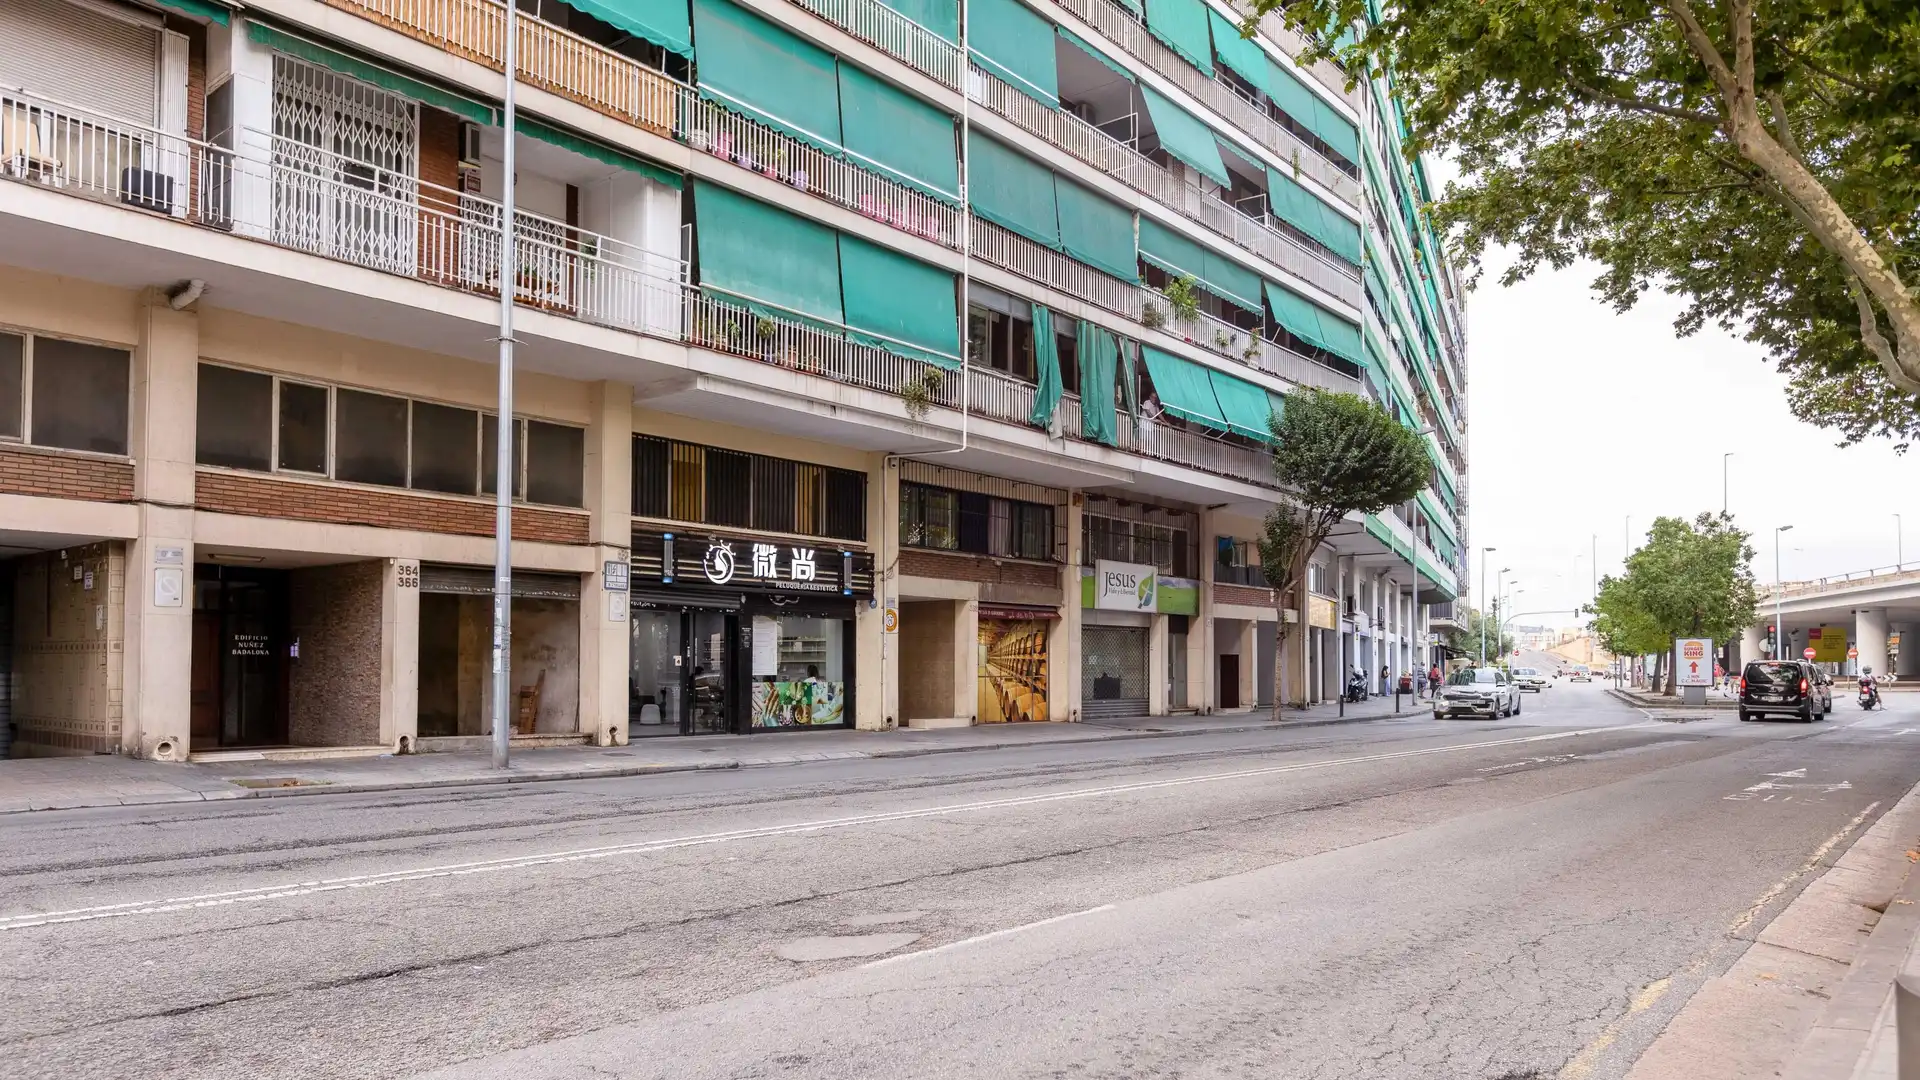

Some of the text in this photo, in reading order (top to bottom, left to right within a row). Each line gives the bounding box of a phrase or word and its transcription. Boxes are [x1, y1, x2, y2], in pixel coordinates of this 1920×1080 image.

[398, 565, 418, 576] 364
[752, 543, 816, 582] 微尚
[398, 577, 418, 588] 366
[1103, 571, 1136, 597] Jesus
